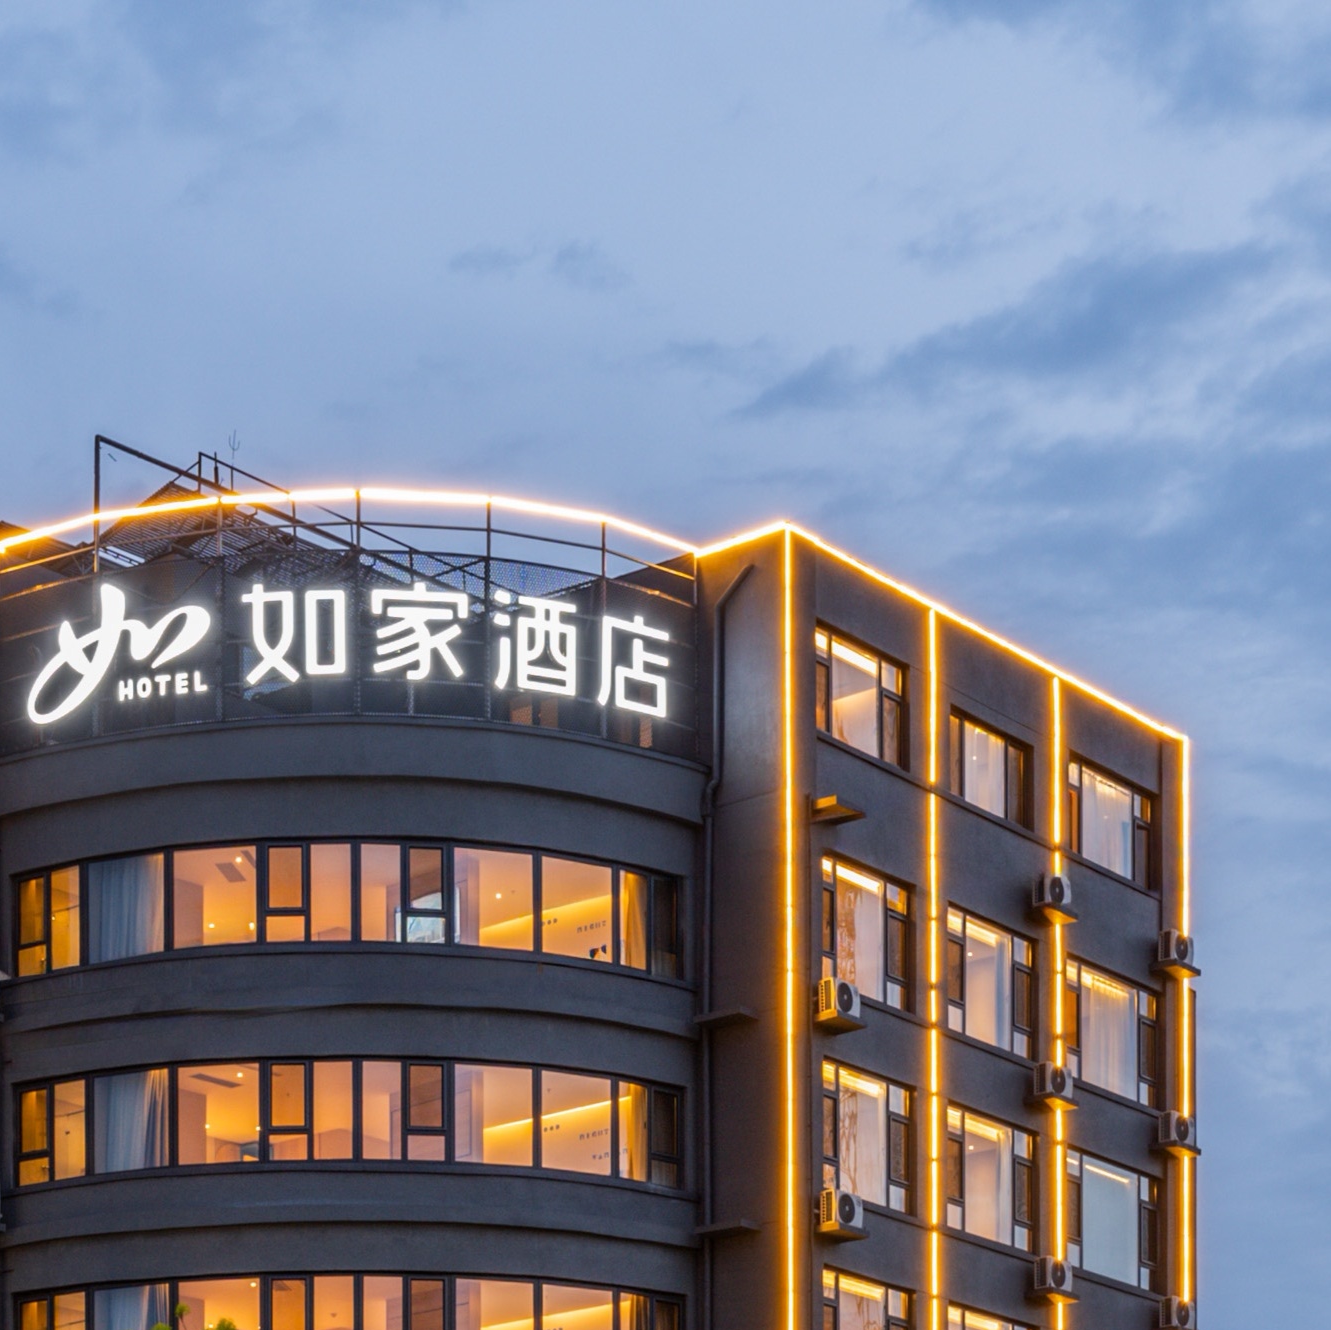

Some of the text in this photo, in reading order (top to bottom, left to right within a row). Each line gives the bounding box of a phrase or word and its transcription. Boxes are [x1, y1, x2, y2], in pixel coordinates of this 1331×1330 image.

[118, 670, 208, 701] HOTEL
[241, 582, 670, 718] 如家酒店
